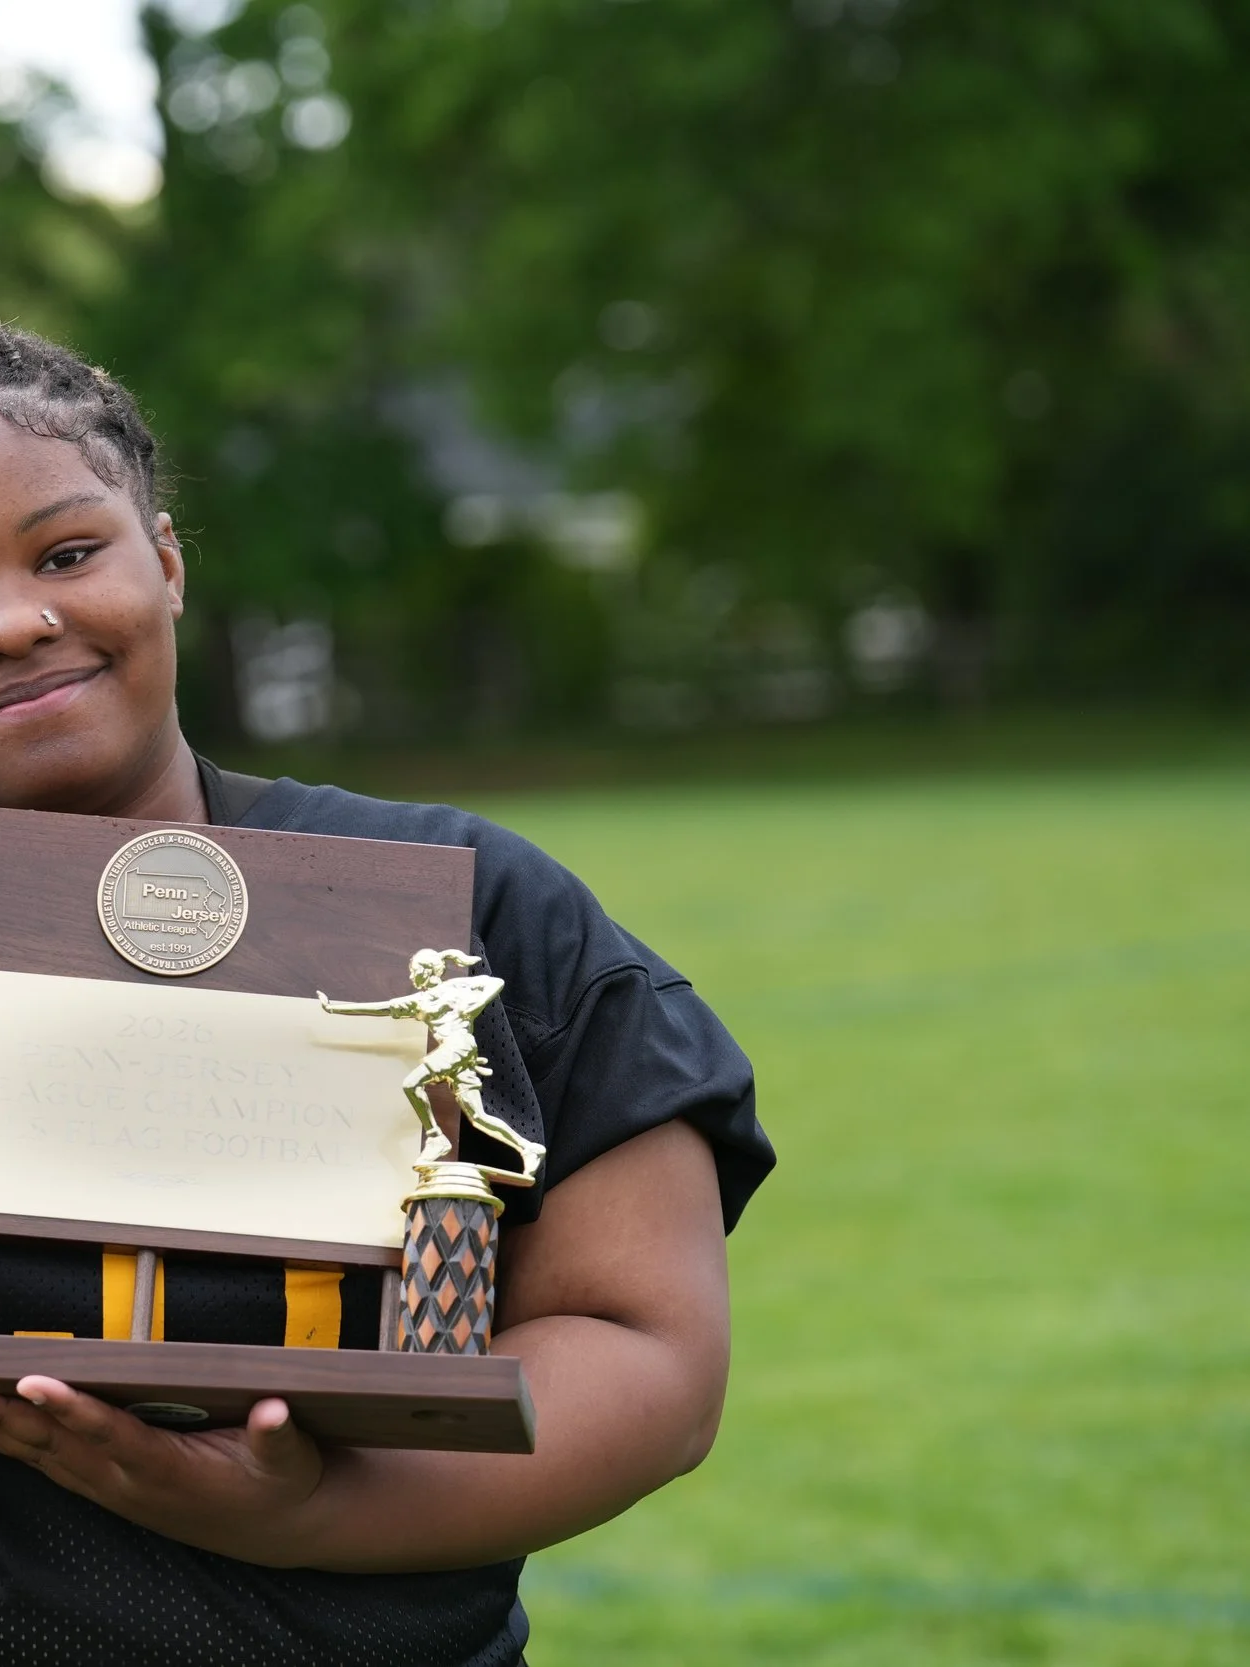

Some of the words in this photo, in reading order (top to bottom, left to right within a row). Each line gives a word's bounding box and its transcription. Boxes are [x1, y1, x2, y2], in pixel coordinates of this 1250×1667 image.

[131, 836, 165, 854] SOCCER
[168, 835, 217, 857] X-COUNTRY
[108, 851, 132, 878] TENNIS
[216, 855, 243, 904] BASKETBALL
[142, 883, 188, 900] Penn
[103, 881, 118, 933] VOLLEYBALL
[171, 905, 230, 925] Jersey
[123, 920, 160, 931] Athletic
[161, 923, 197, 935] League
[218, 908, 242, 947] SOFTBALL
[116, 934, 137, 956] FIELD
[138, 952, 146, 961] &
[178, 945, 220, 968] BASEBALL
[146, 956, 176, 969] TRACK
[116, 1013, 215, 1044] 2026
[19, 1041, 307, 1088] PENN-JERSEY
[143, 1090, 356, 1130] CHAMPION
[65, 1120, 162, 1150] FLAG
